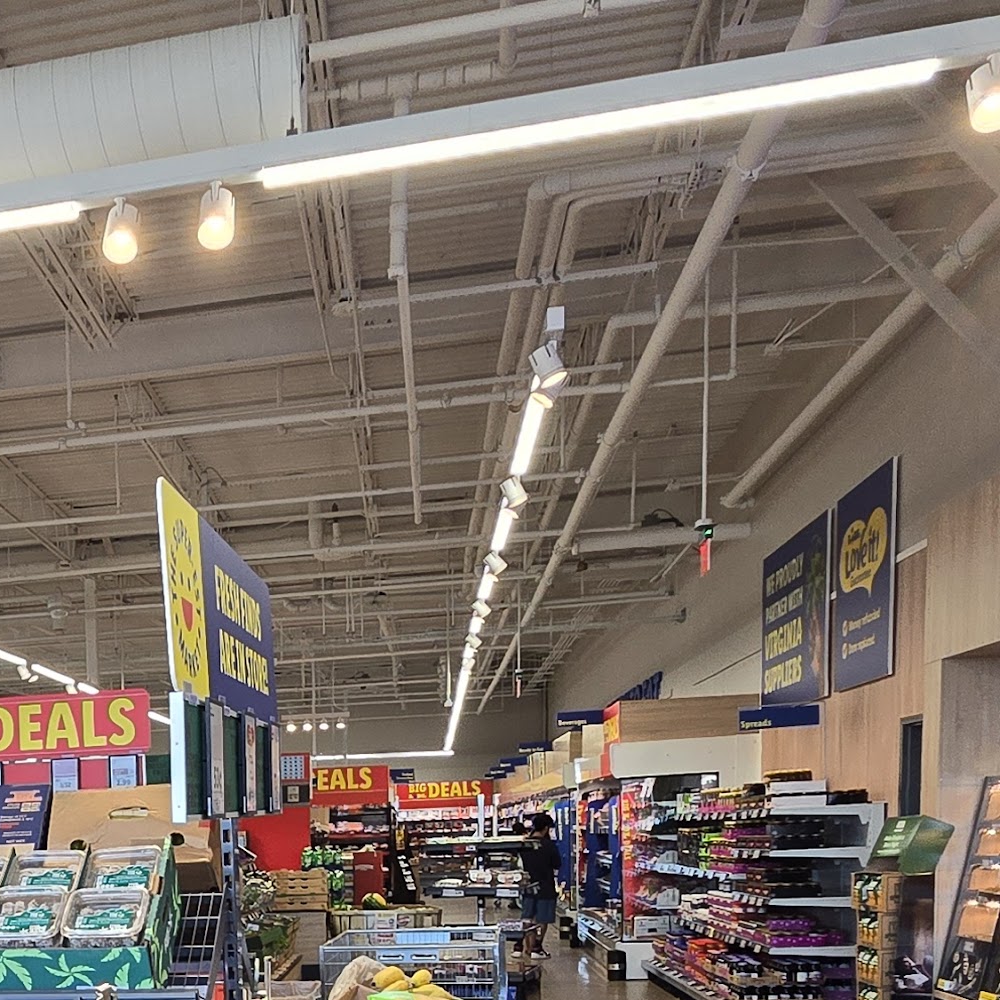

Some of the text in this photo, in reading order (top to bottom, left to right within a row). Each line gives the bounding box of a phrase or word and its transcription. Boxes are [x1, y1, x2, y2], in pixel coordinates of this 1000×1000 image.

[214, 564, 240, 624] FRESH
[219, 629, 236, 680] ARE
[234, 638, 246, 682] IN
[764, 616, 803, 662] VIRGINIA
[764, 654, 803, 694] SUPPLIERS
[739, 718, 772, 729] Spreads
[313, 766, 373, 792] EALS
[408, 780, 482, 798] BIG DEALS
